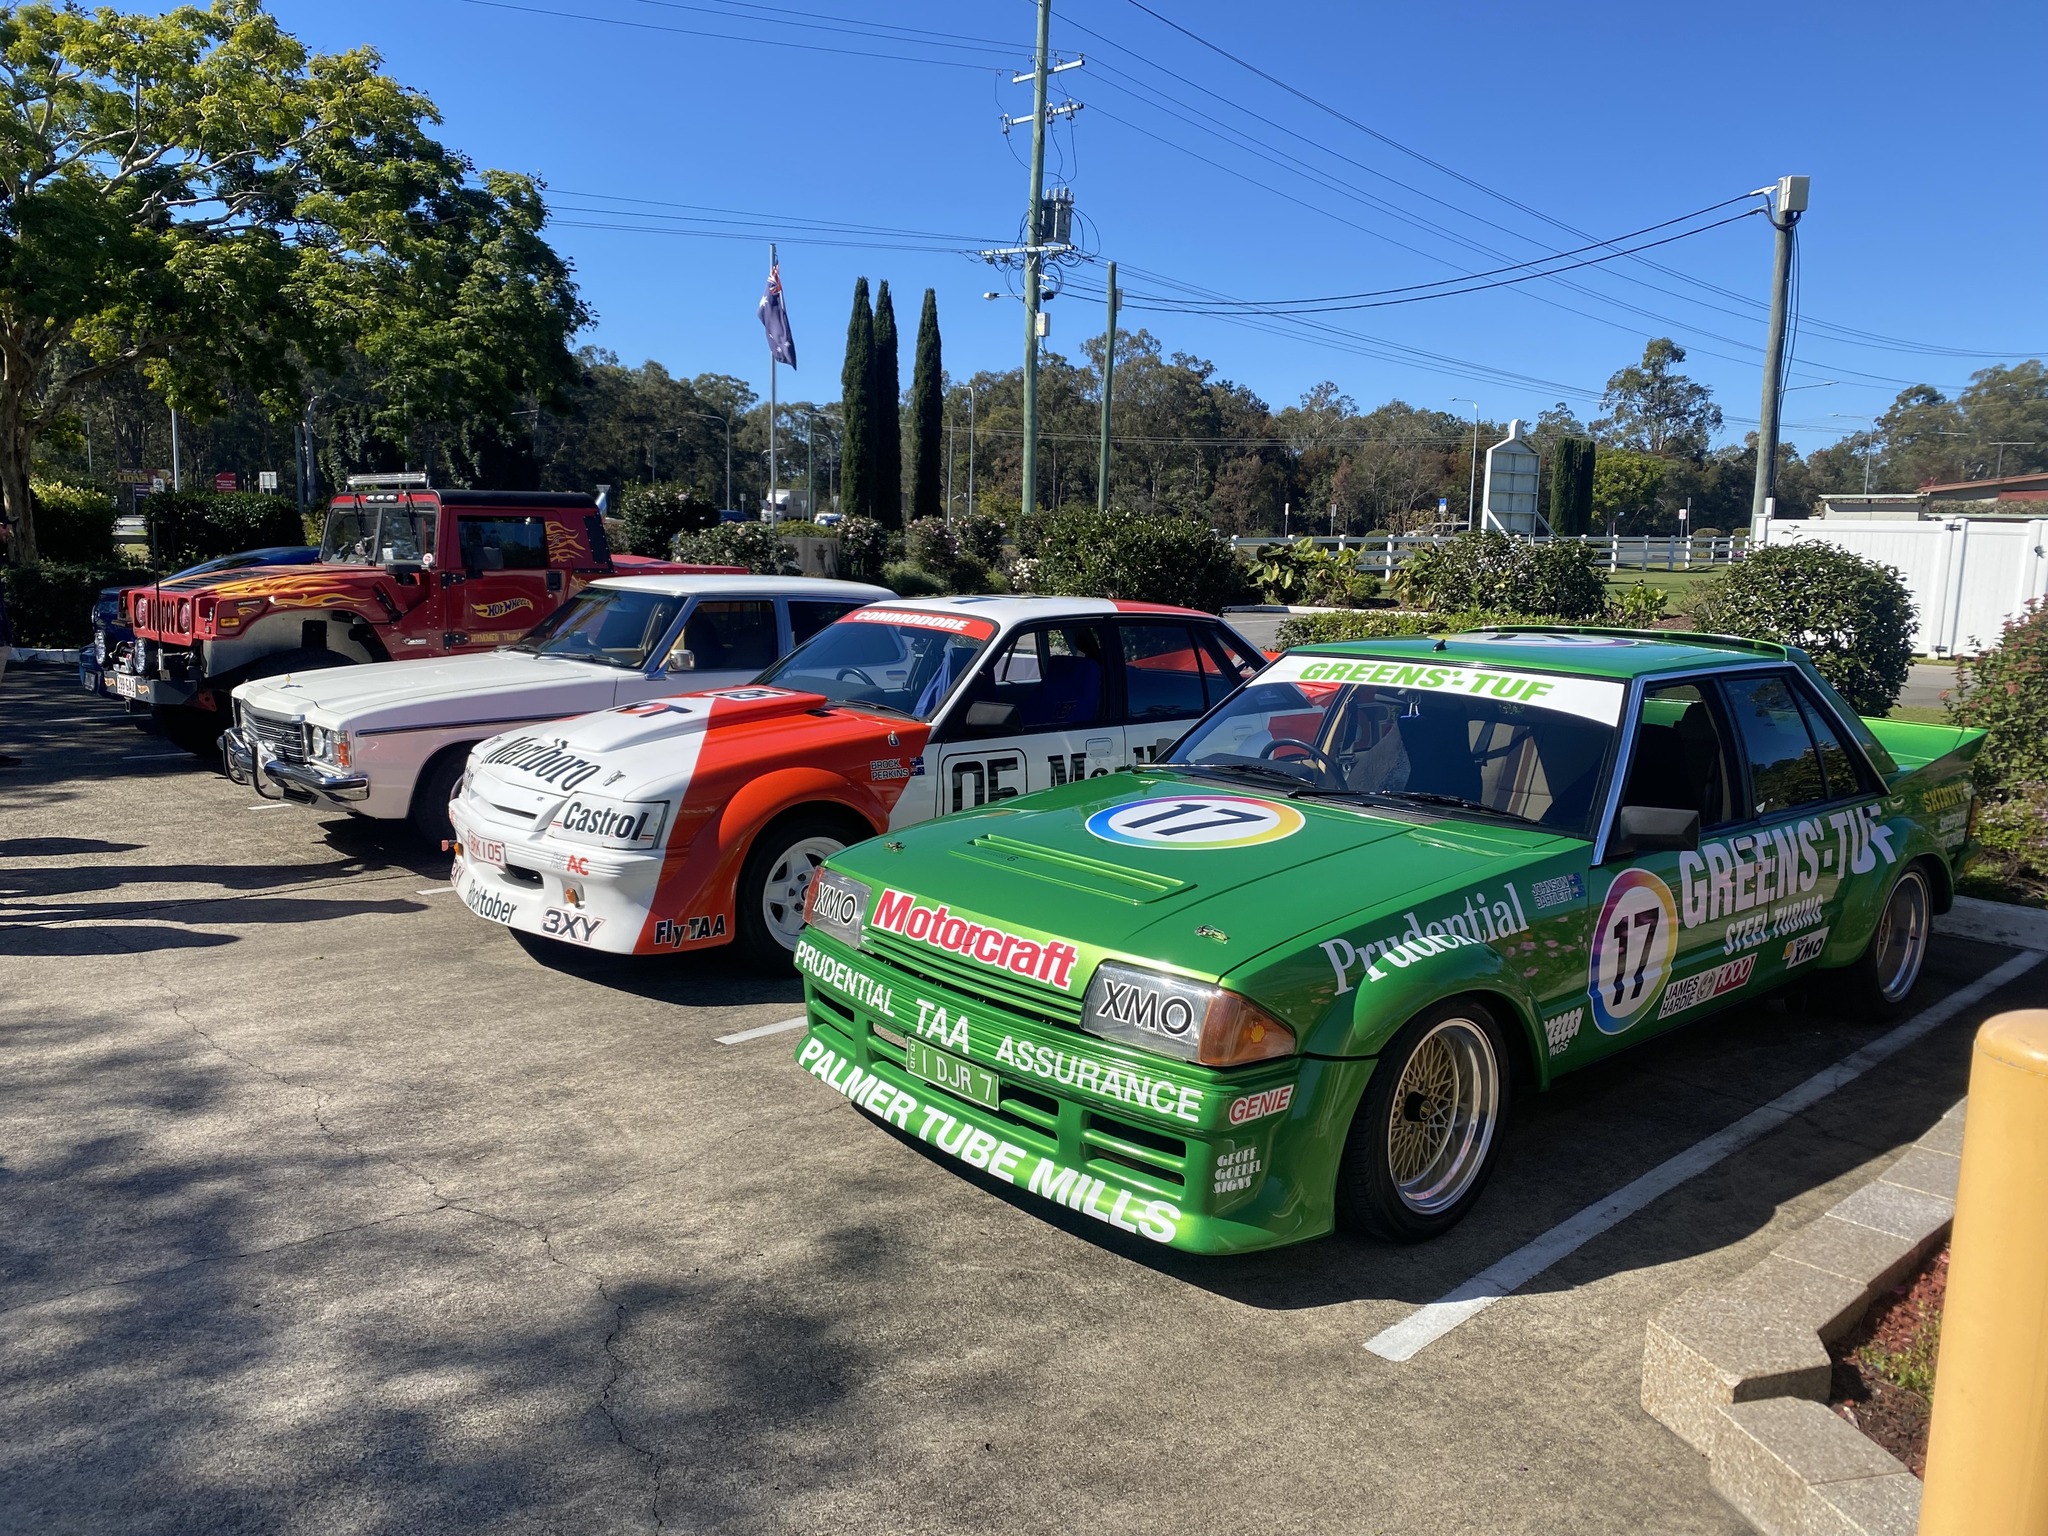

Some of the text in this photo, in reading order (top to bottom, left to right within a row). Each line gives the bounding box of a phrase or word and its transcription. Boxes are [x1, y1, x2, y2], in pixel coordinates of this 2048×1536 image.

[487, 598, 530, 617] HOT WHEELS
[853, 611, 970, 631] COMMODORE
[480, 738, 602, 792] Marlboro
[869, 758, 902, 770] BROCK
[871, 767, 910, 781] PERKINS
[562, 800, 650, 842] Castrol
[1119, 803, 1270, 836] 17
[566, 854, 589, 876] AC
[1531, 875, 1569, 896] JOHNSON
[1534, 888, 1572, 909] BARTLETT
[812, 881, 857, 926] XMO
[542, 907, 606, 945] 3XY
[654, 914, 726, 948] Fly TAA
[870, 887, 1079, 992] Motorcraft
[1318, 882, 1530, 996] Prudential
[1722, 893, 1824, 956] STEEL TUBING
[1612, 906, 1660, 1007] 17
[1790, 938, 1824, 966] XMO
[1659, 992, 1695, 1017] HARDIE
[1665, 976, 1700, 1001] JAMES
[1096, 977, 1195, 1037] XMO
[794, 940, 1203, 1124] PRUDENTIAL TAA ASSURANCE
[936, 1056, 973, 1094] DJR
[979, 1073, 993, 1101] 7
[1229, 1085, 1293, 1124] GENIE
[798, 1037, 1181, 1243] PALMER TUBE MILLS
[1214, 1160, 1262, 1180] GOEBEL
[1216, 1147, 1257, 1167] GEOFF
[1213, 1175, 1253, 1194] SIGNS
